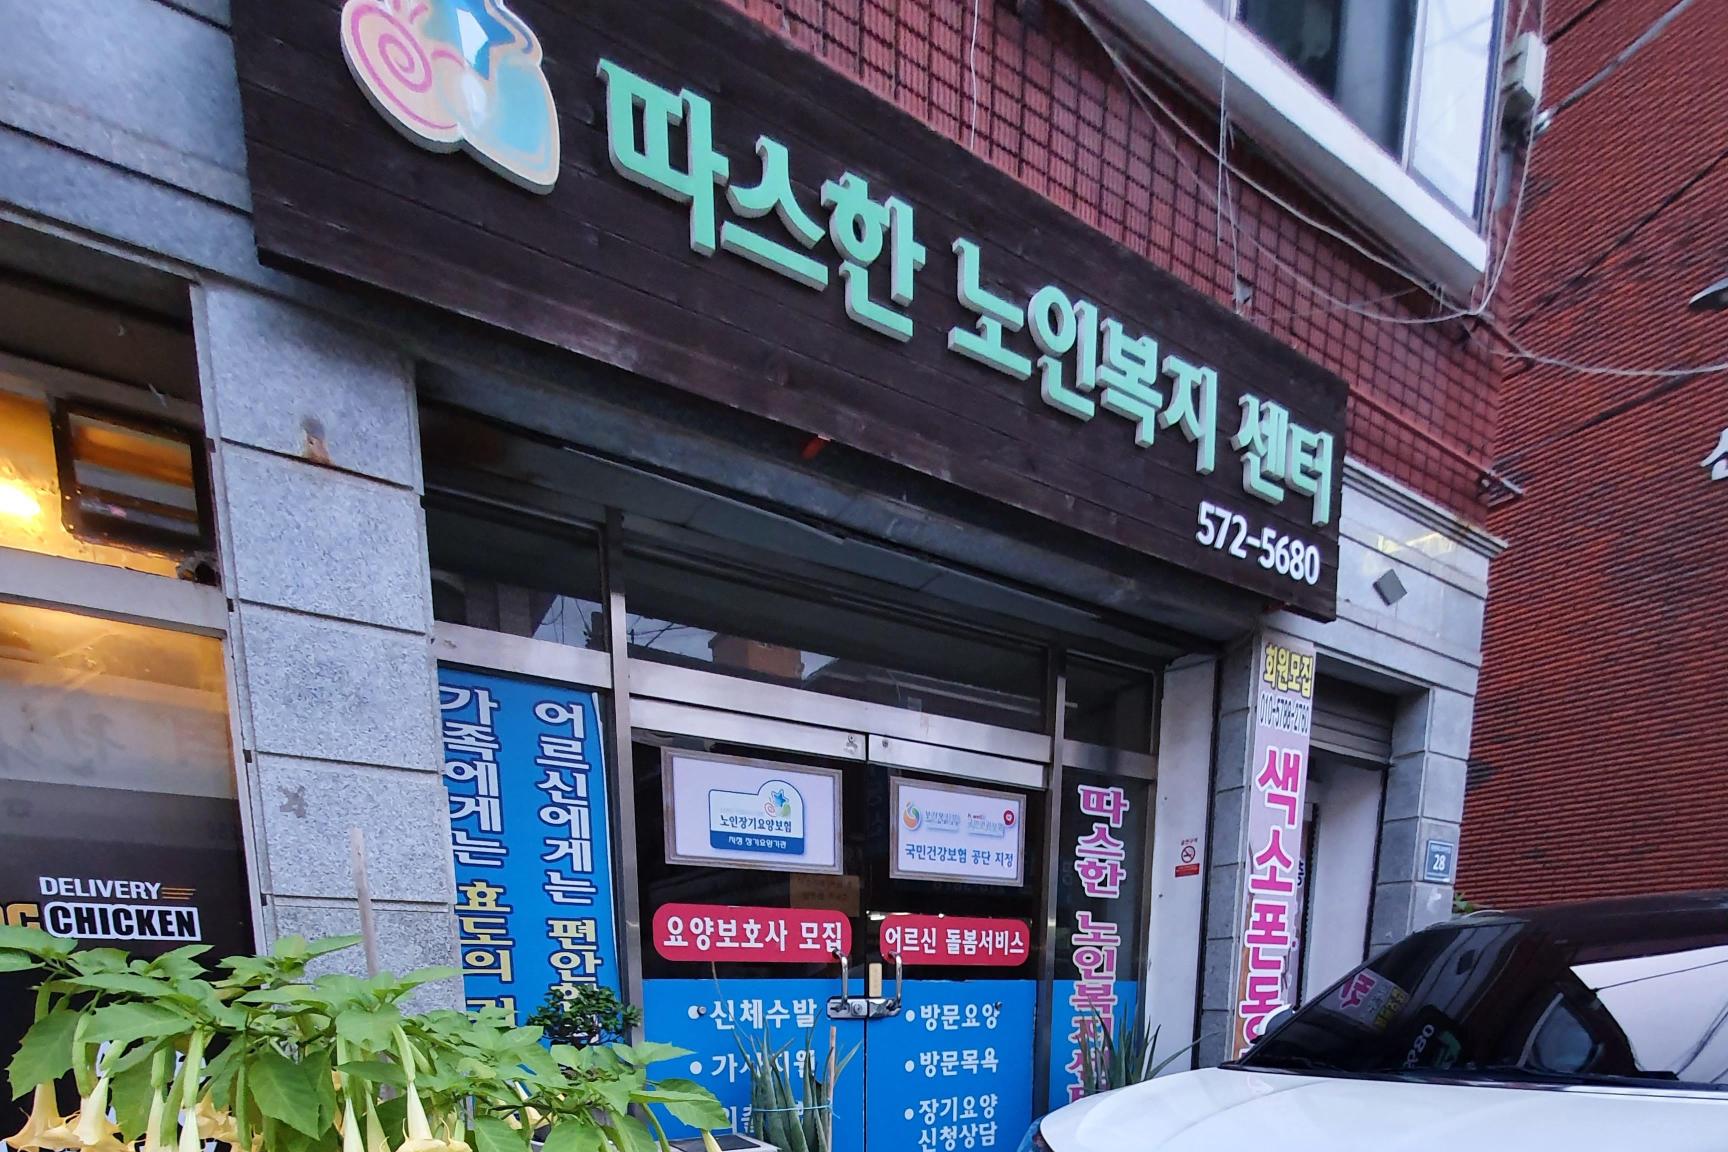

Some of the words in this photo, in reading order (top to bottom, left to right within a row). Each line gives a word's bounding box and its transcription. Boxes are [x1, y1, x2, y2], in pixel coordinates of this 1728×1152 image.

[598, 58, 926, 343] 따스한
[947, 237, 1217, 475] 노인복지
[1231, 392, 1334, 527] 센터
[1196, 501, 1320, 585] 572-5680
[1263, 643, 1313, 699] 회원모집
[439, 685, 508, 866] 가족에게는
[534, 702, 598, 904] 어르신에게는
[720, 814, 792, 833] 노인장기요양보험
[1074, 785, 1130, 898] 따스한
[905, 843, 967, 863] 국민건강보험
[971, 849, 991, 866] 공단
[995, 852, 1014, 868] 지정
[1432, 853, 1447, 871] 28
[39, 876, 161, 900] DELIVERY
[1240, 748, 1301, 1057] 색소폰동
[46, 903, 199, 940] CHICKEN
[455, 881, 514, 982] 효도의
[663, 915, 788, 953] 요양보호사
[798, 921, 842, 953] 모집
[884, 926, 937, 954] 어르신
[945, 928, 1025, 955] 돌봄서비스
[1068, 910, 1121, 1047] 노인복지
[709, 998, 818, 1030] 신체수발
[920, 1003, 1000, 1031] 방문요양
[919, 1047, 999, 1077] 방문목욕
[918, 1093, 998, 1125] 장기요양
